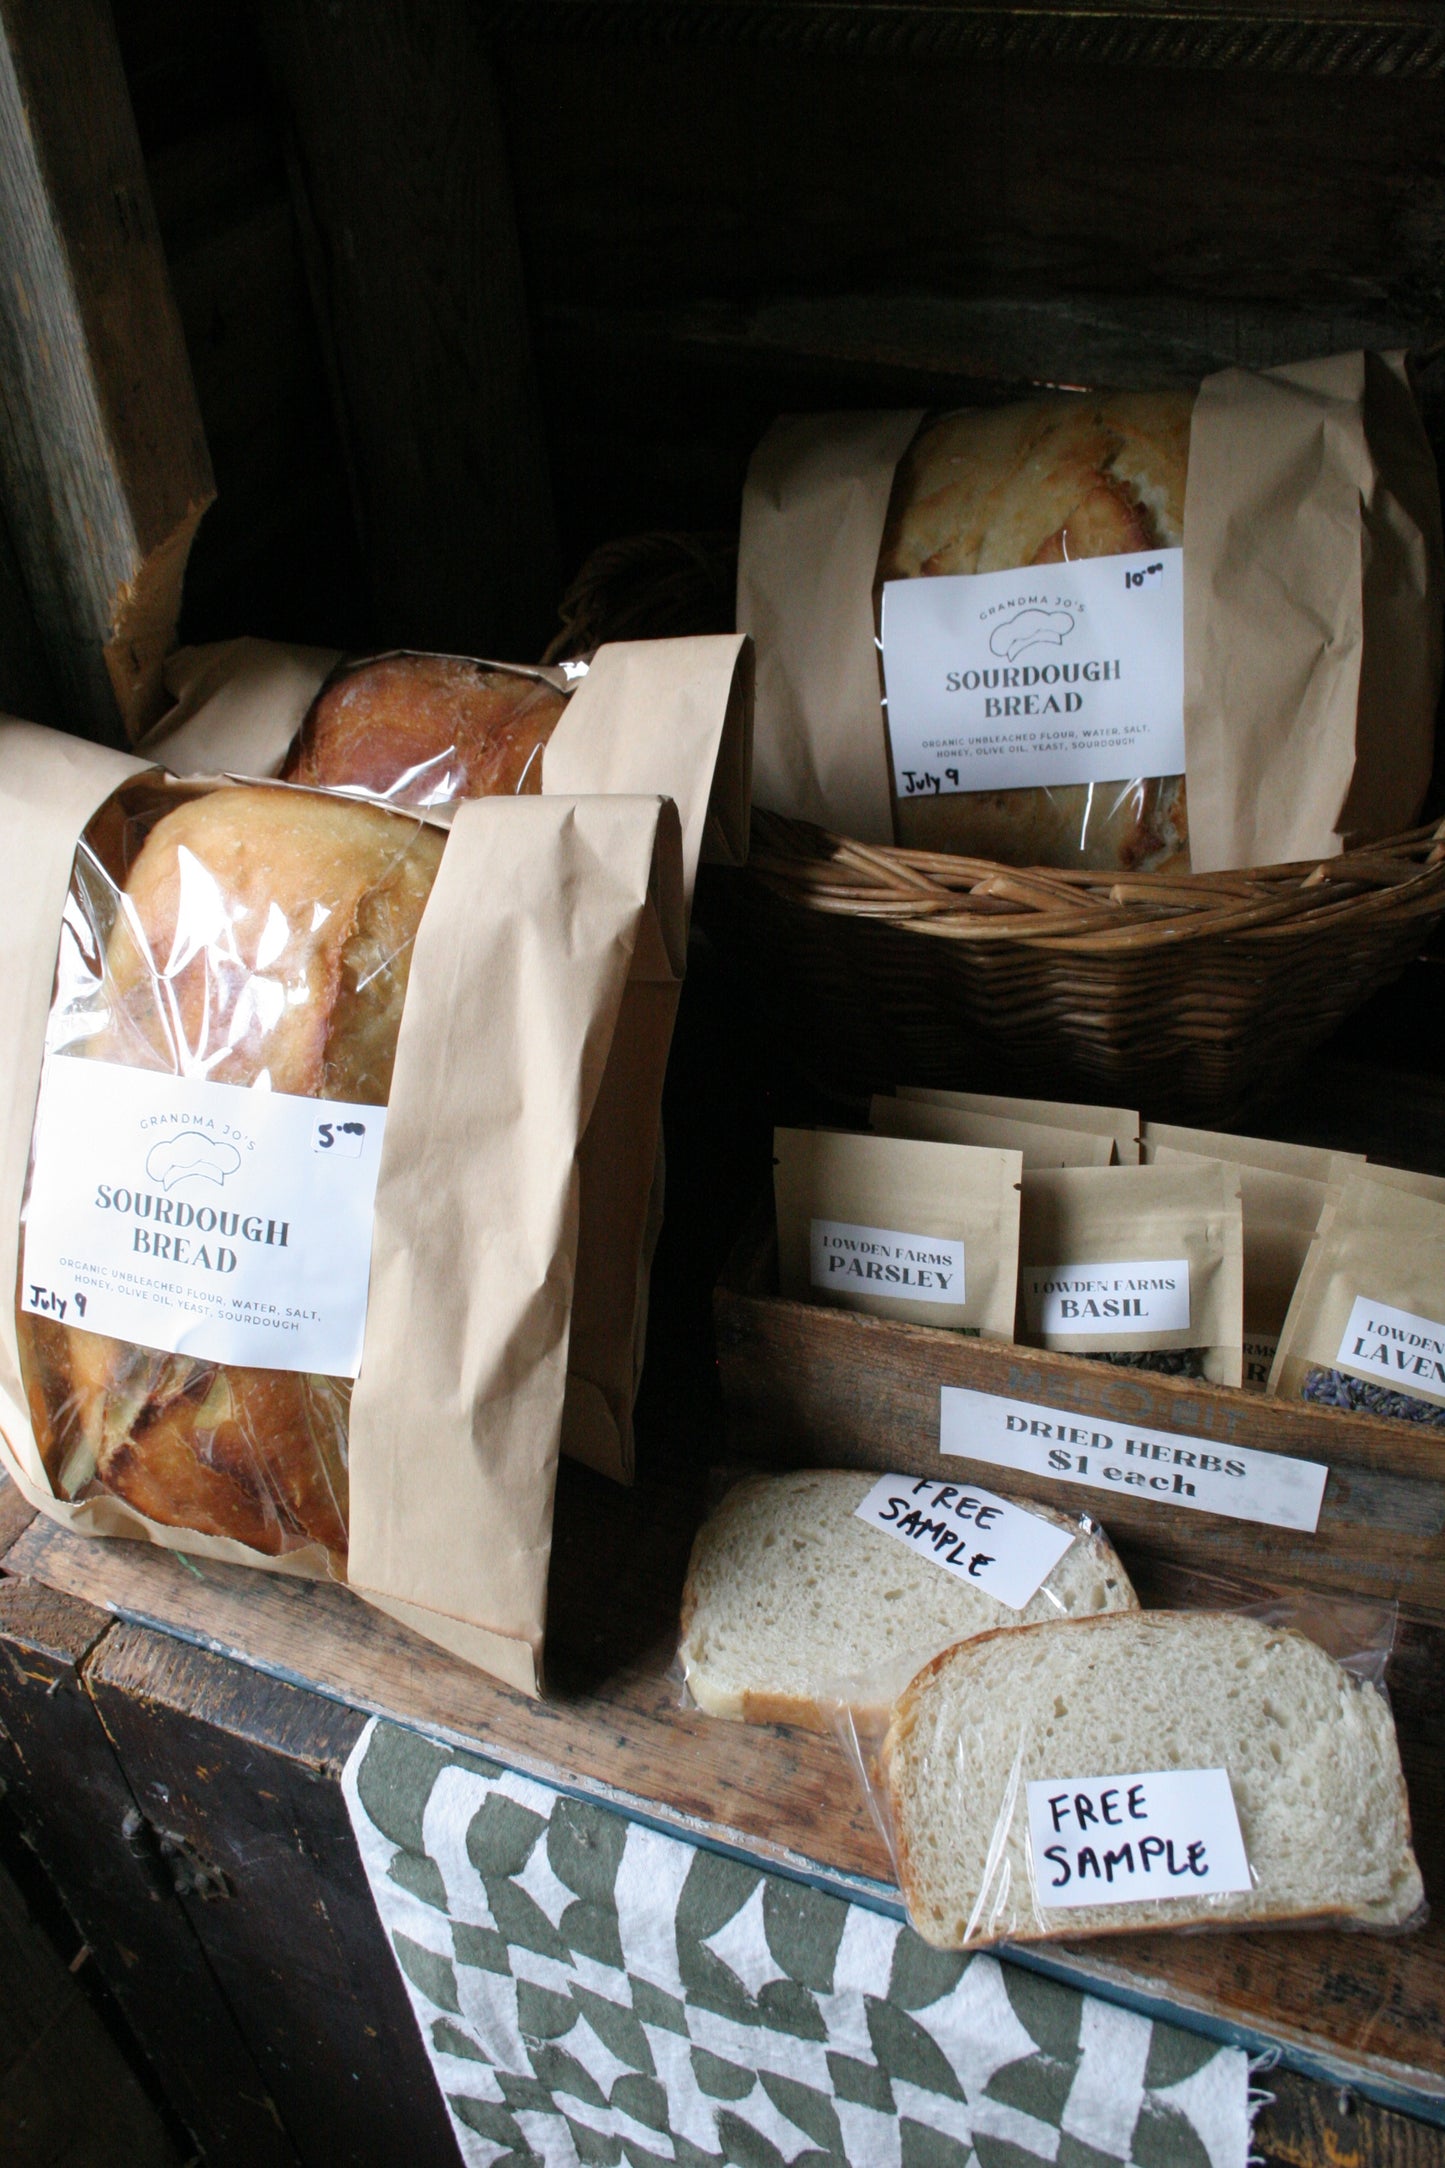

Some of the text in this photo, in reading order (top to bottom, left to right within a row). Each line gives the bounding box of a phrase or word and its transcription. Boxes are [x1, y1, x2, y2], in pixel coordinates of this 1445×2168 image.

[979, 596, 1087, 621] GRANDMA JO'S
[946, 659, 1121, 692] SOURDOUGH
[984, 692, 1084, 719] BREAD
[922, 738, 965, 749] ORGANIC
[968, 733, 1037, 746] UNBLEACHED
[1040, 729, 1079, 741] FLOUR,
[1082, 727, 1122, 738] WATER,
[936, 748, 973, 759] HONEY,
[975, 746, 1004, 756] OLIVE
[1032, 742, 1068, 752] YEAST,
[1072, 737, 1136, 749] SOURDOUGH
[902, 767, 960, 795] July 9
[140, 1112, 256, 1152] GRANDMA JO'S
[94, 1184, 291, 1248] SOURDOUGH
[132, 1227, 238, 1274] BREAD
[823, 1235, 953, 1267] LOWDEN FARMS
[59, 1257, 322, 1322] ORGANIC UNBLEACHED FLOUR, WATER, SALT,
[828, 1255, 953, 1290] PARSLEY
[1033, 1278, 1176, 1294] LOWDEN FARMS
[30, 1285, 87, 1319] July 9
[74, 1273, 300, 1331] HONEY, OLIVE OIL, YEAST, SOURDOUGH
[1060, 1298, 1149, 1319] BASIL
[1366, 1320, 1445, 1355] LOWDEN
[1005, 1414, 1247, 1478] DRIED HERBS
[1047, 1449, 1196, 1497] $1 each
[911, 1478, 1005, 1530] FREE
[878, 1497, 997, 1577] SAMPLE
[1048, 1784, 1148, 1833] FREE
[1043, 1836, 1209, 1887] SAMPLE
